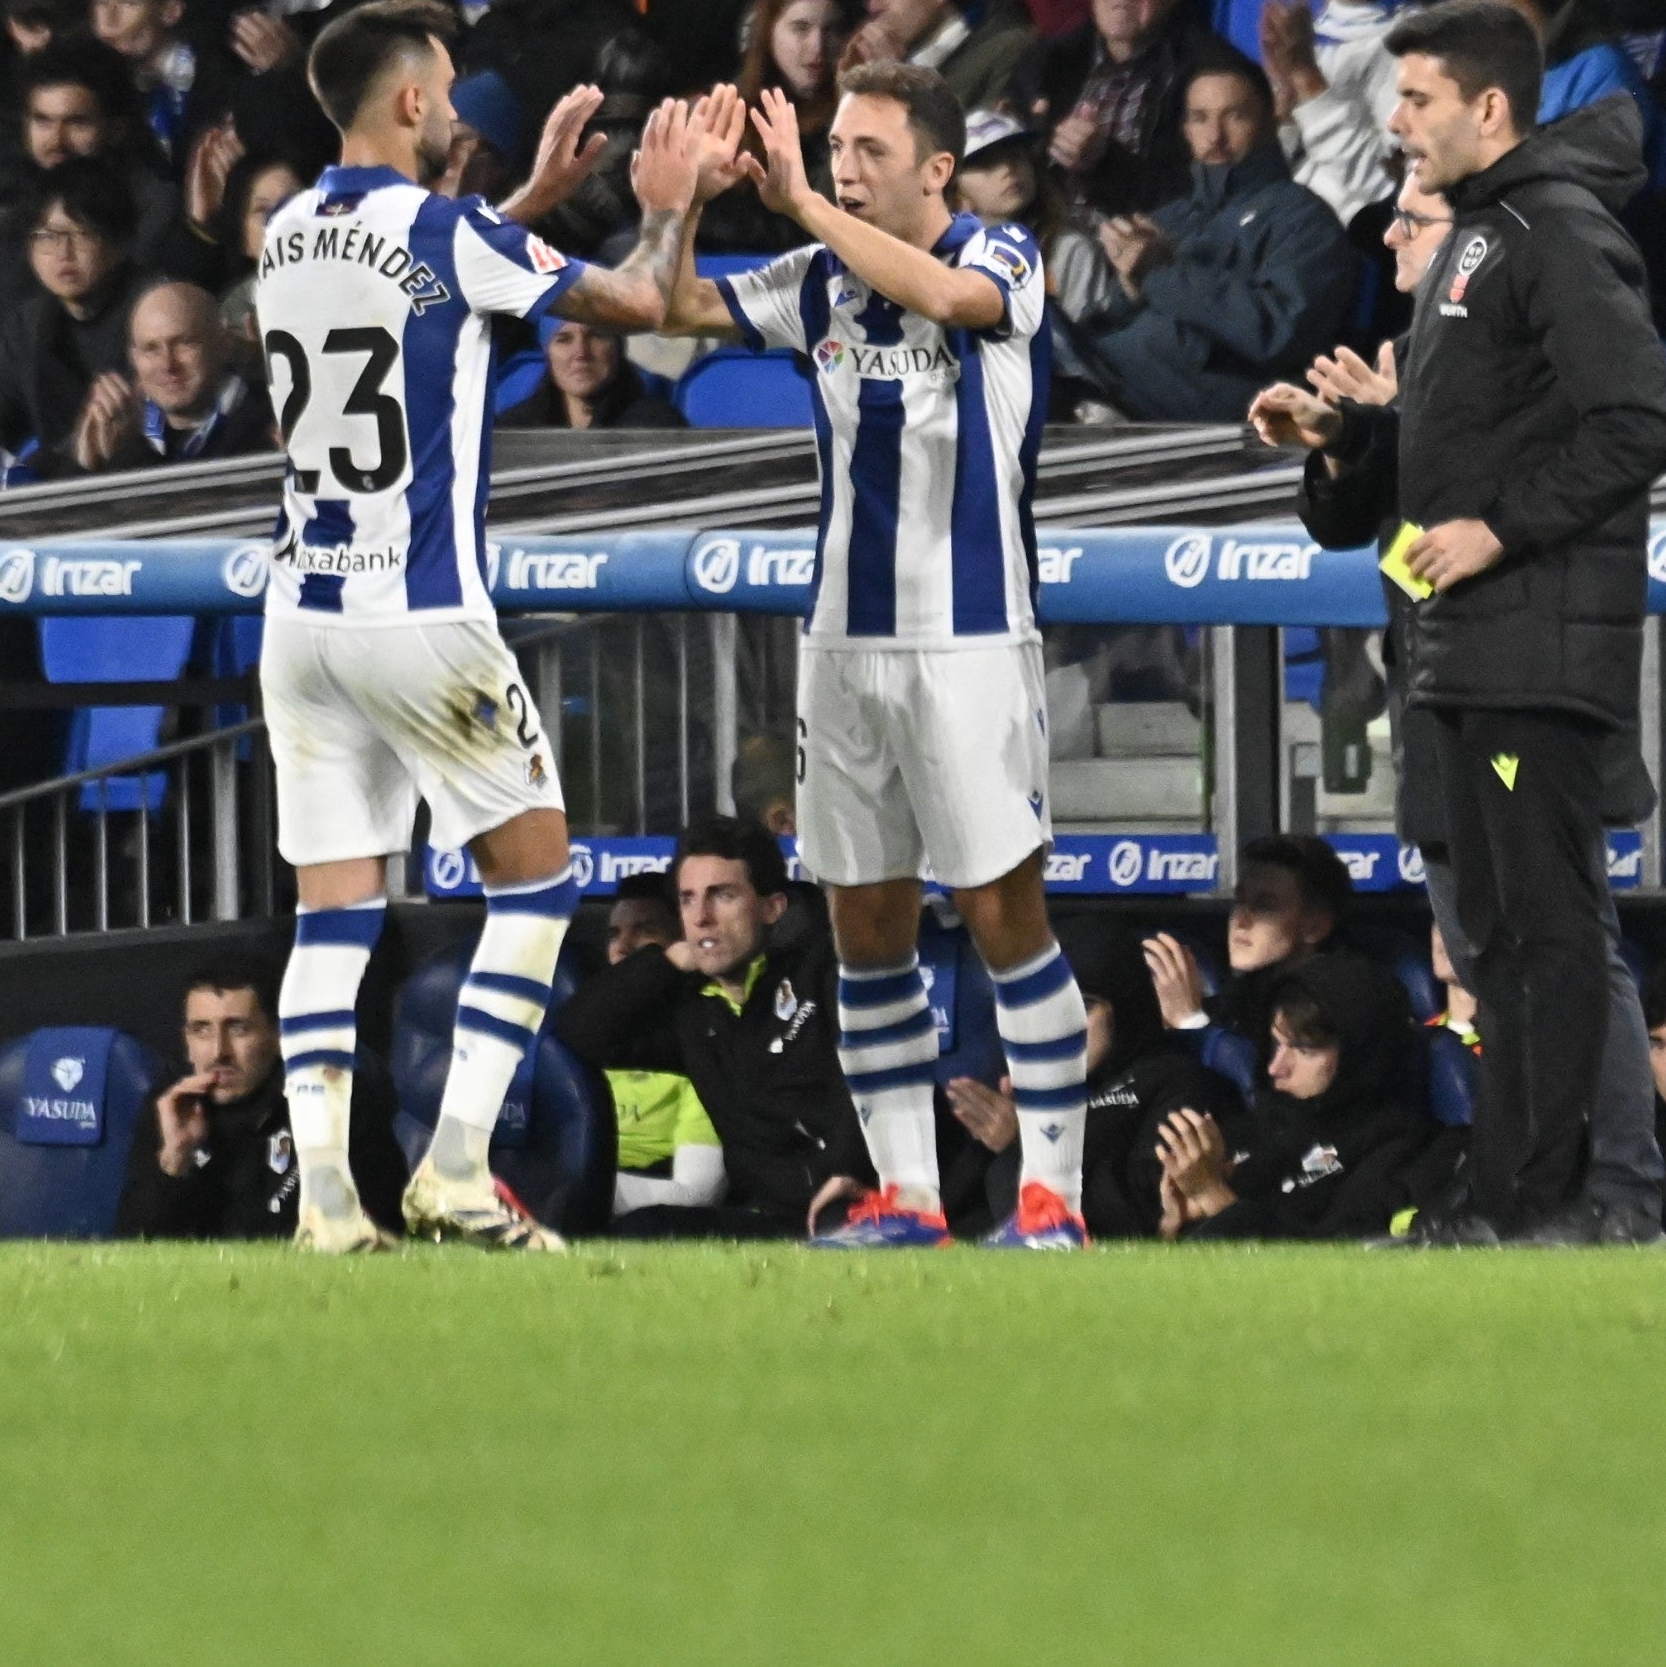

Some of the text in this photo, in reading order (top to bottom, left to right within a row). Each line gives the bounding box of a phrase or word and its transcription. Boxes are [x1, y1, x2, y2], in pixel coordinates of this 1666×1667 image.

[258, 220, 451, 317] AIS MÉNDEZ
[848, 344, 956, 374] YASUDA
[265, 326, 408, 495] 23
[748, 545, 816, 585] Iriz
[25, 1096, 97, 1122] YASUDA
